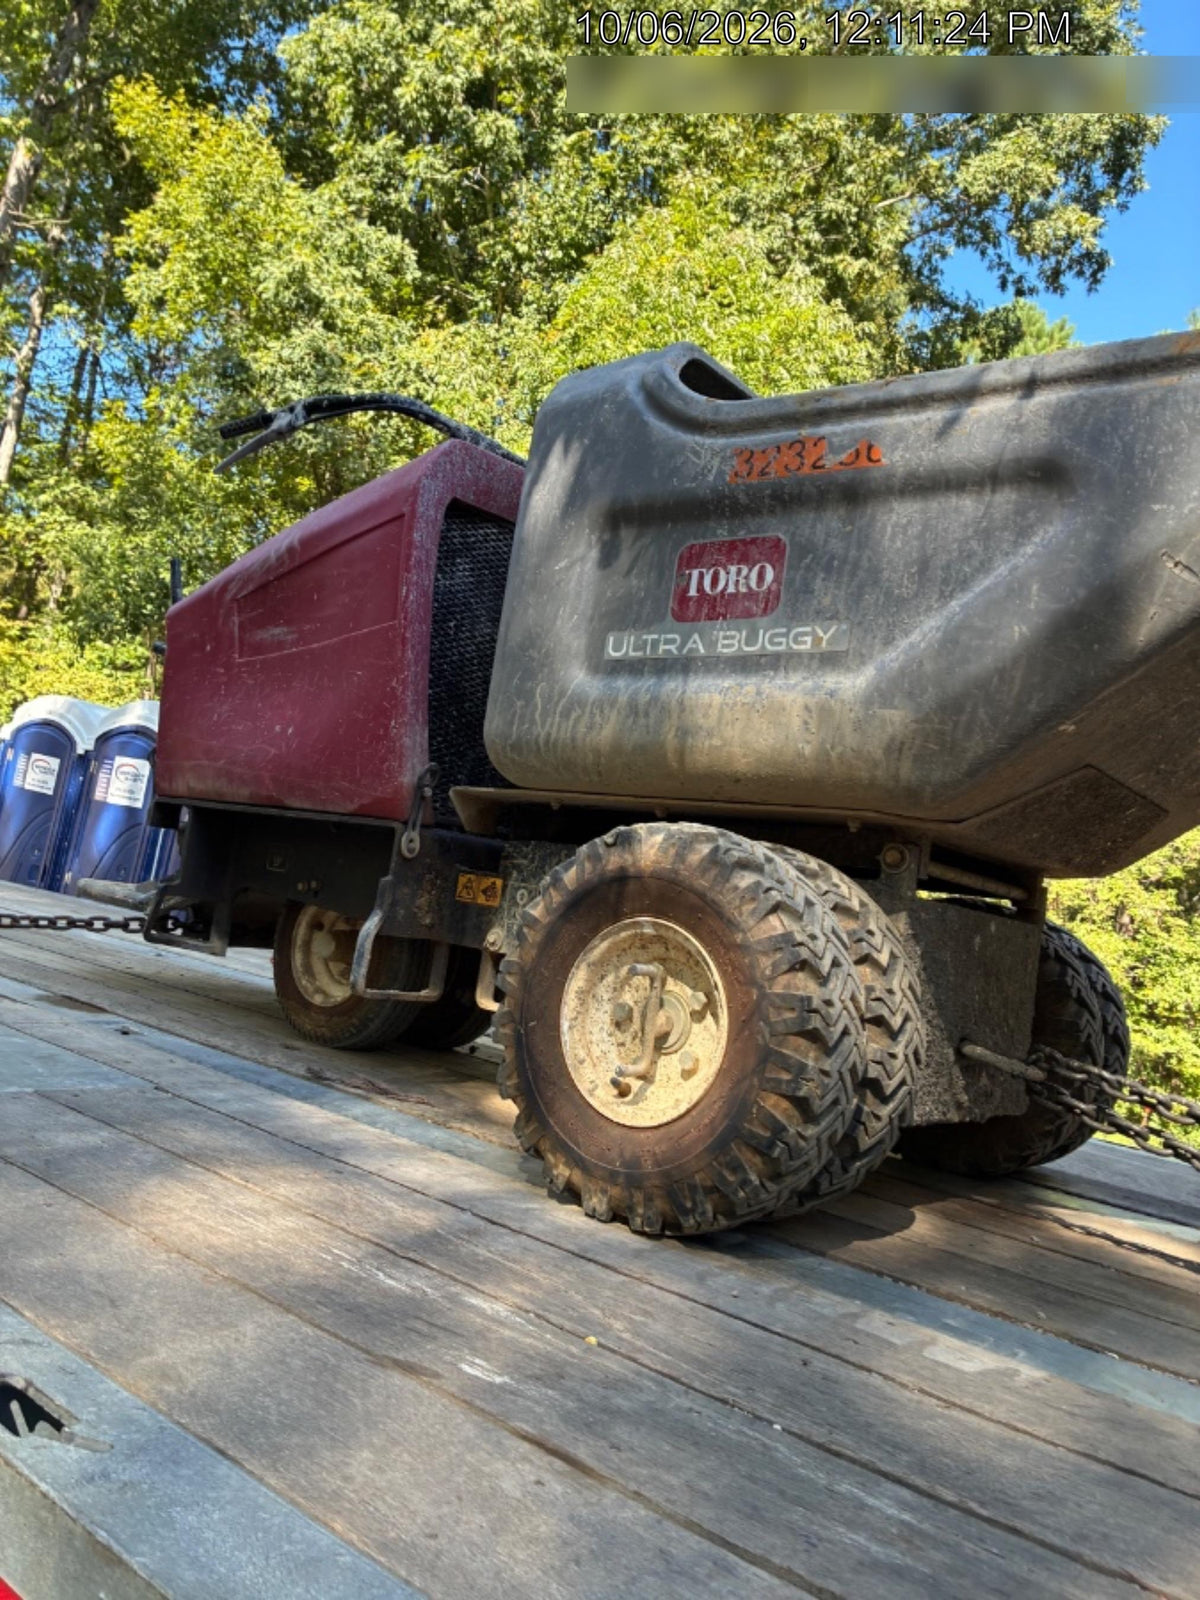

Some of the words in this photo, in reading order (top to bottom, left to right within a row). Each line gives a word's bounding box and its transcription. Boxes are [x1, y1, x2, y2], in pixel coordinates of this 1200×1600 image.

[686, 562, 774, 597] TORO
[607, 632, 705, 657] ULTRA
[717, 625, 838, 653] BUGGY
